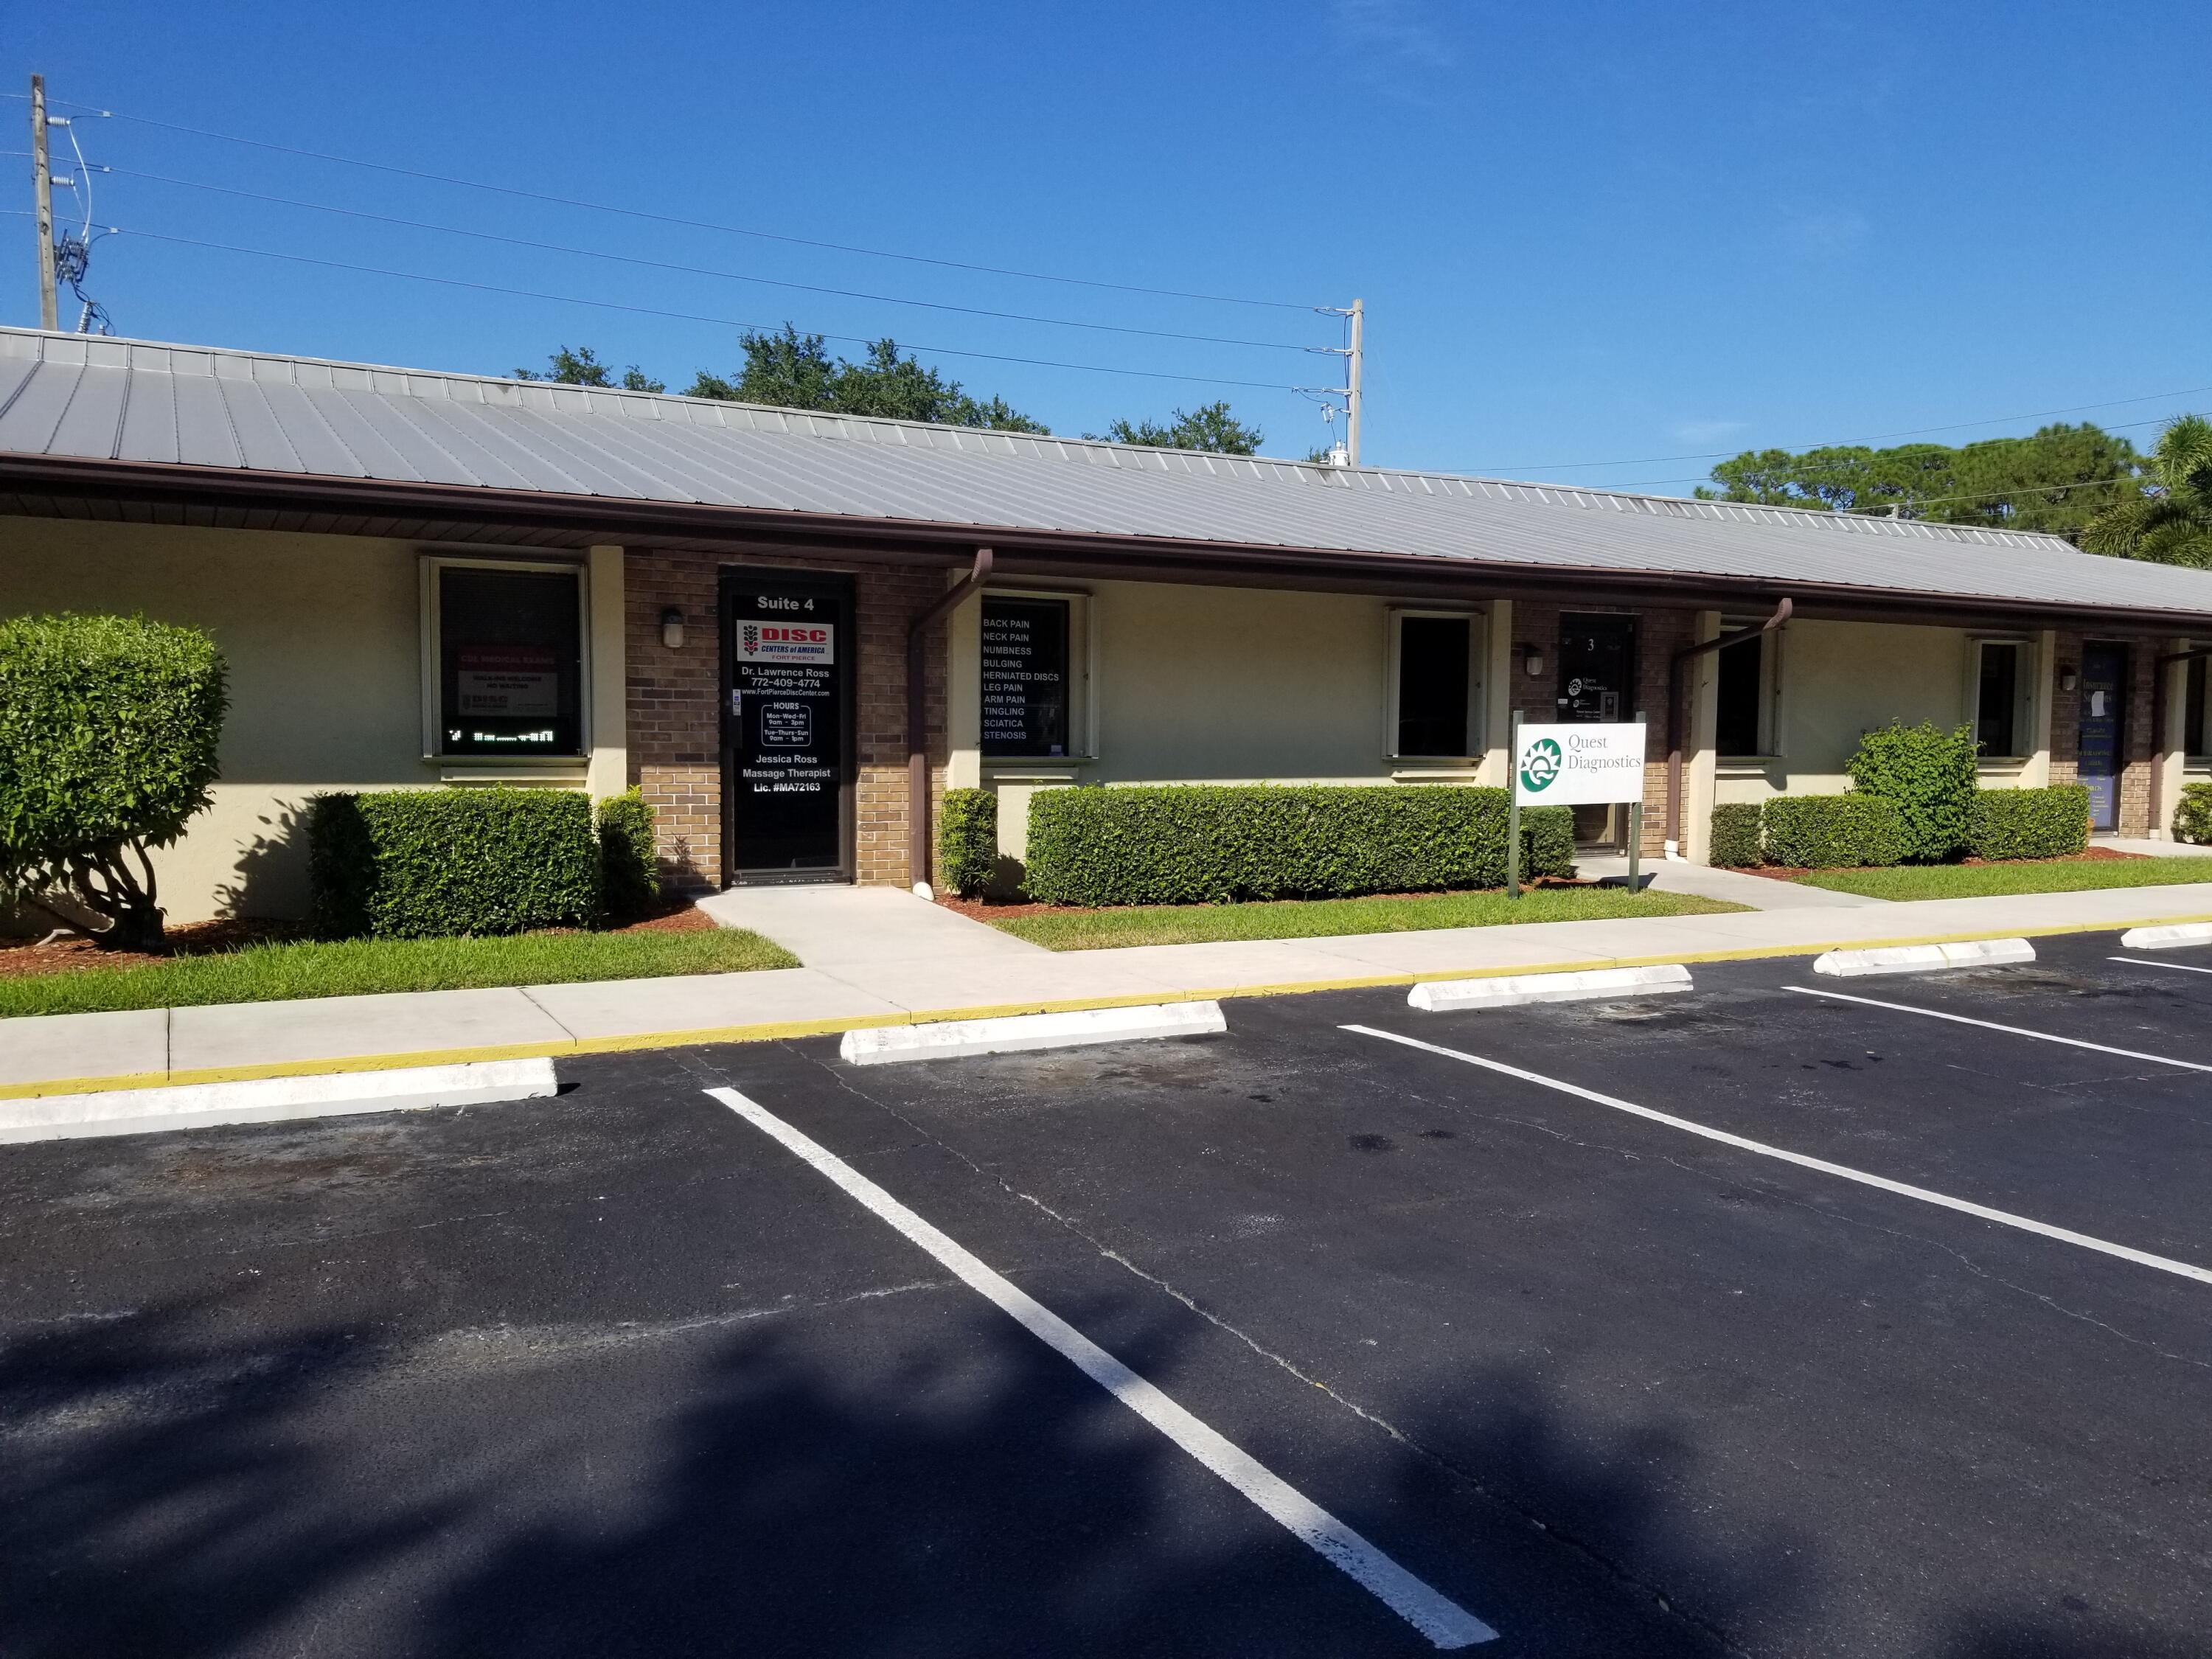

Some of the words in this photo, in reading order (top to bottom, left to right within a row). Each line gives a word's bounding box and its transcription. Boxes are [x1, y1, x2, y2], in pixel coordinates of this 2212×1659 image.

[757, 596, 799, 610] Suite
[804, 598, 814, 611] 4
[984, 619, 1008, 627] BACK
[1010, 620, 1029, 629] PAIN
[762, 627, 827, 642] DISC
[983, 633, 1007, 641] NECK
[1009, 633, 1029, 641] PAIN
[762, 645, 789, 653] CENTERS
[1587, 639, 1594, 650] 3
[983, 646, 1032, 655] NUMBNESS
[983, 659, 1023, 668] BULGING
[742, 667, 755, 675] Dr.
[758, 667, 804, 677] Lawrence
[806, 669, 830, 678] Ross
[983, 672, 1032, 681] HERNIATED
[1034, 672, 1060, 681] DISCS
[751, 678, 821, 688] 772-409-4774
[742, 688, 830, 697] www.FortPierceDiscCenter.com
[984, 684, 1001, 692] LEG
[1004, 684, 1023, 692] PAIN
[984, 695, 1004, 703] ARM
[1006, 696, 1026, 704] PAIN
[773, 702, 799, 710] HOURS
[984, 707, 1024, 715] TINGLING
[984, 720, 1023, 728] SCIATICA
[984, 731, 1026, 740] STENOSIS
[1568, 734, 1609, 752] Quest
[756, 754, 792, 763] Jessica
[794, 754, 818, 764] Ross
[1568, 755, 1641, 773] Diagnostics
[742, 769, 785, 779] Massage
[787, 769, 831, 779] Therapist
[754, 783, 771, 792] Lic.
[773, 782, 821, 792] #MA72163
